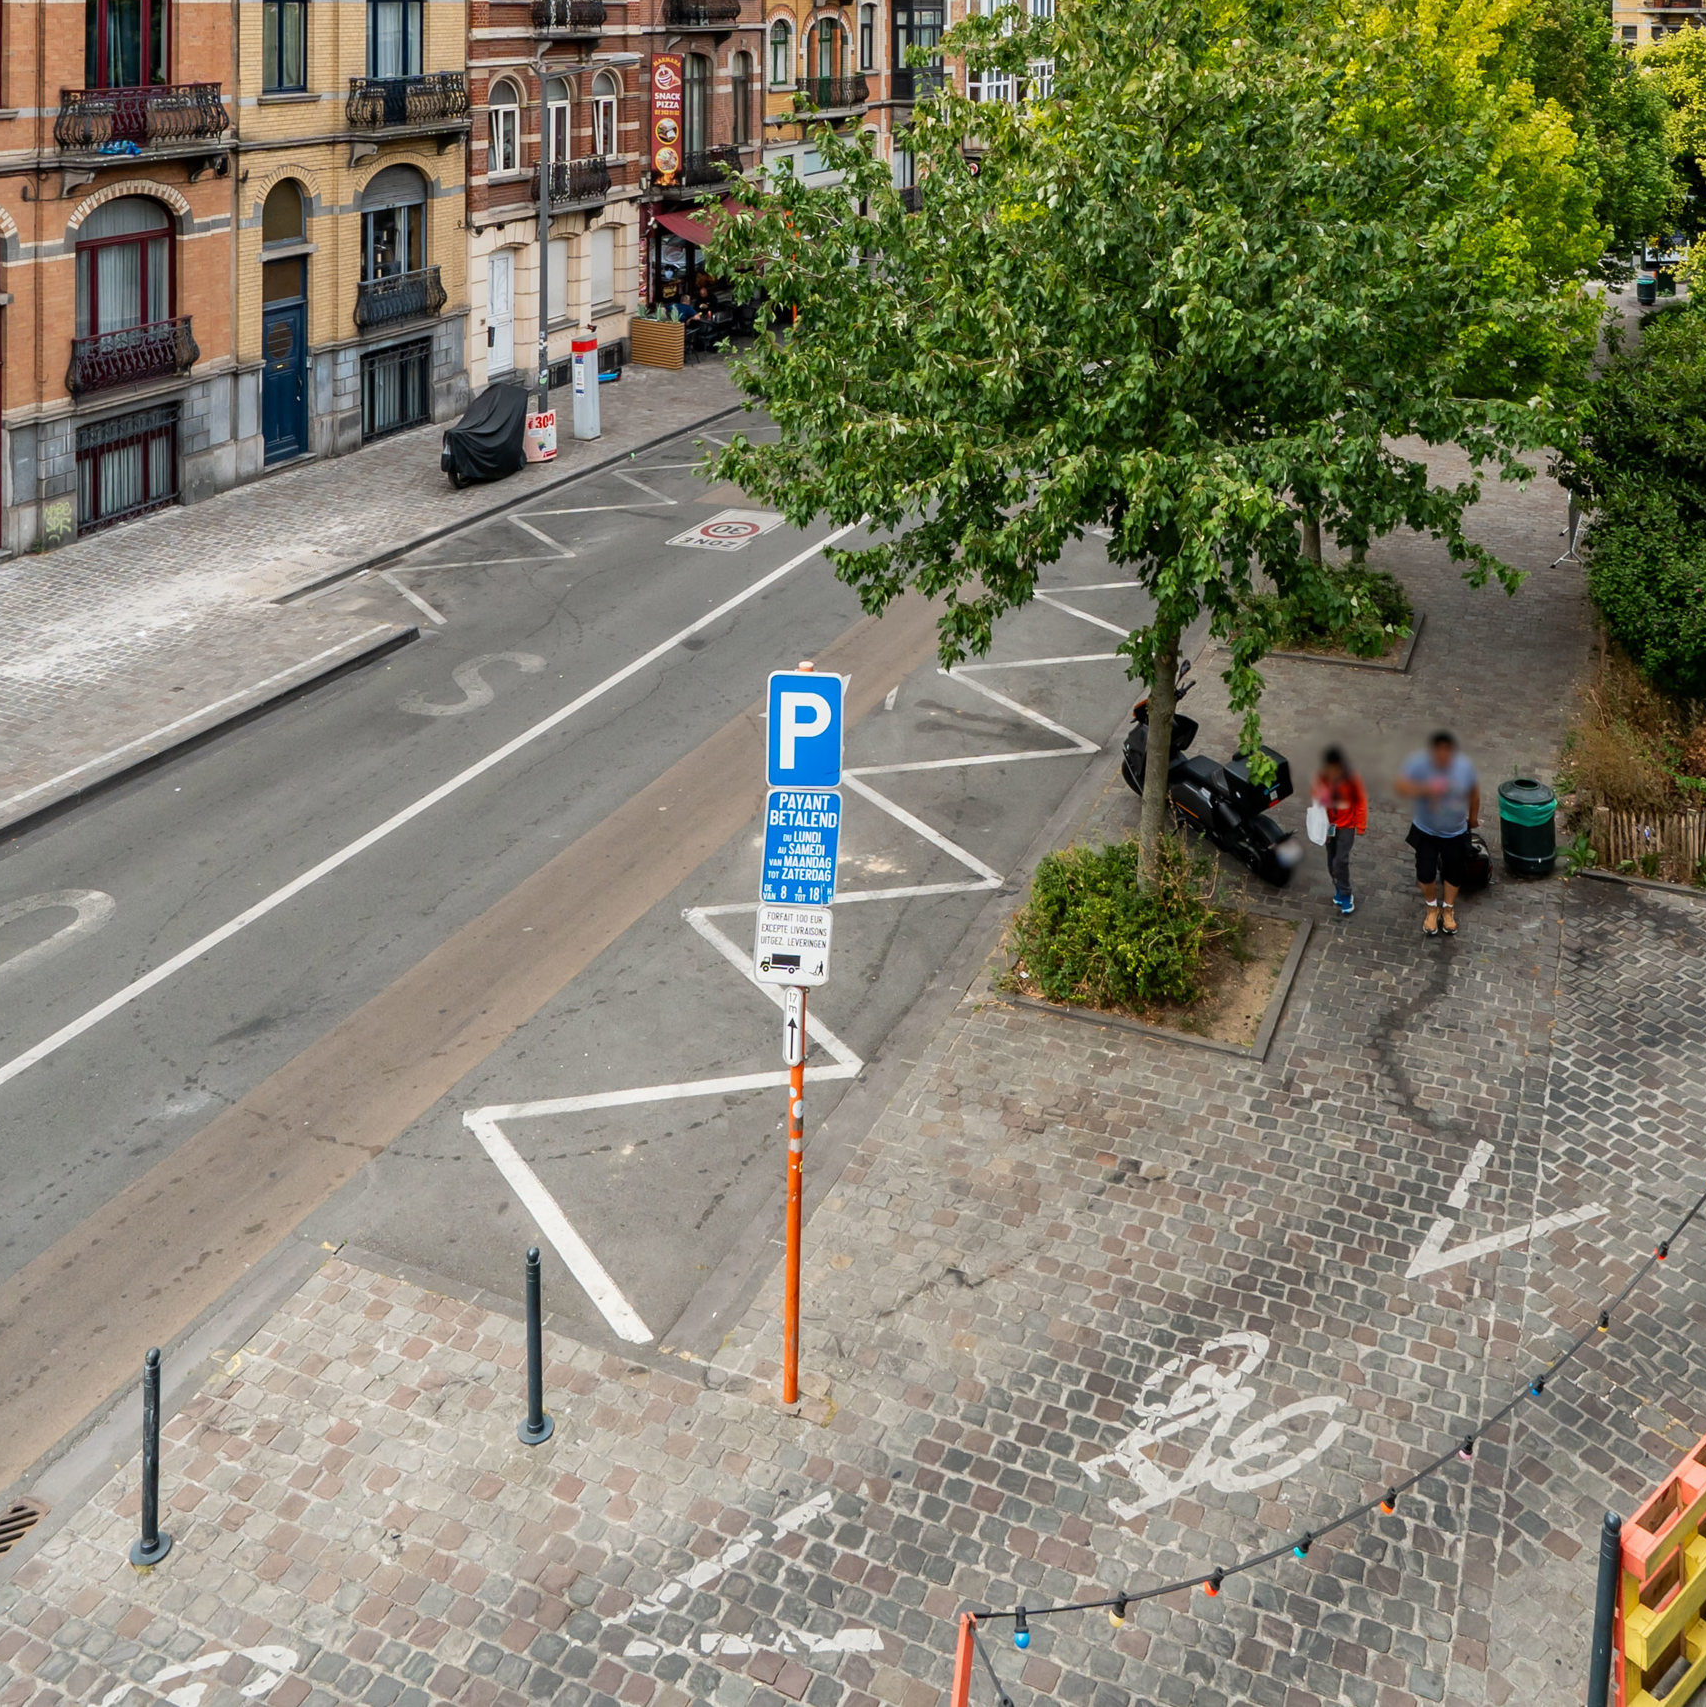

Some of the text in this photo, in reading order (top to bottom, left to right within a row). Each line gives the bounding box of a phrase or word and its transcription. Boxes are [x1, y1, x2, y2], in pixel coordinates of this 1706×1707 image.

[654, 92, 681, 101] SNACK
[656, 101, 679, 109] PIZZA
[711, 525, 748, 535] 30
[679, 537, 739, 548] ZONE
[779, 692, 832, 770] P
[779, 793, 830, 811] PAYANT
[769, 810, 838, 828] BETALEND
[783, 831, 821, 843] DU LUNDI
[777, 843, 825, 856] AU SAMEDI
[769, 855, 832, 869] VAN MAANDAG
[768, 868, 831, 882] TOT ZATERDAG
[764, 884, 772, 892] DE
[780, 885, 787, 899] 8
[797, 886, 802, 894] A
[809, 887, 820, 901] 18
[763, 892, 776, 900] VAN
[795, 894, 806, 902] TOT
[767, 912, 823, 924] FORFAIT 100 EUR
[761, 923, 827, 936] EXCEPTE LIVRAISONS
[787, 938, 827, 948] LEVERINGEN
[789, 992, 797, 1003] 17
